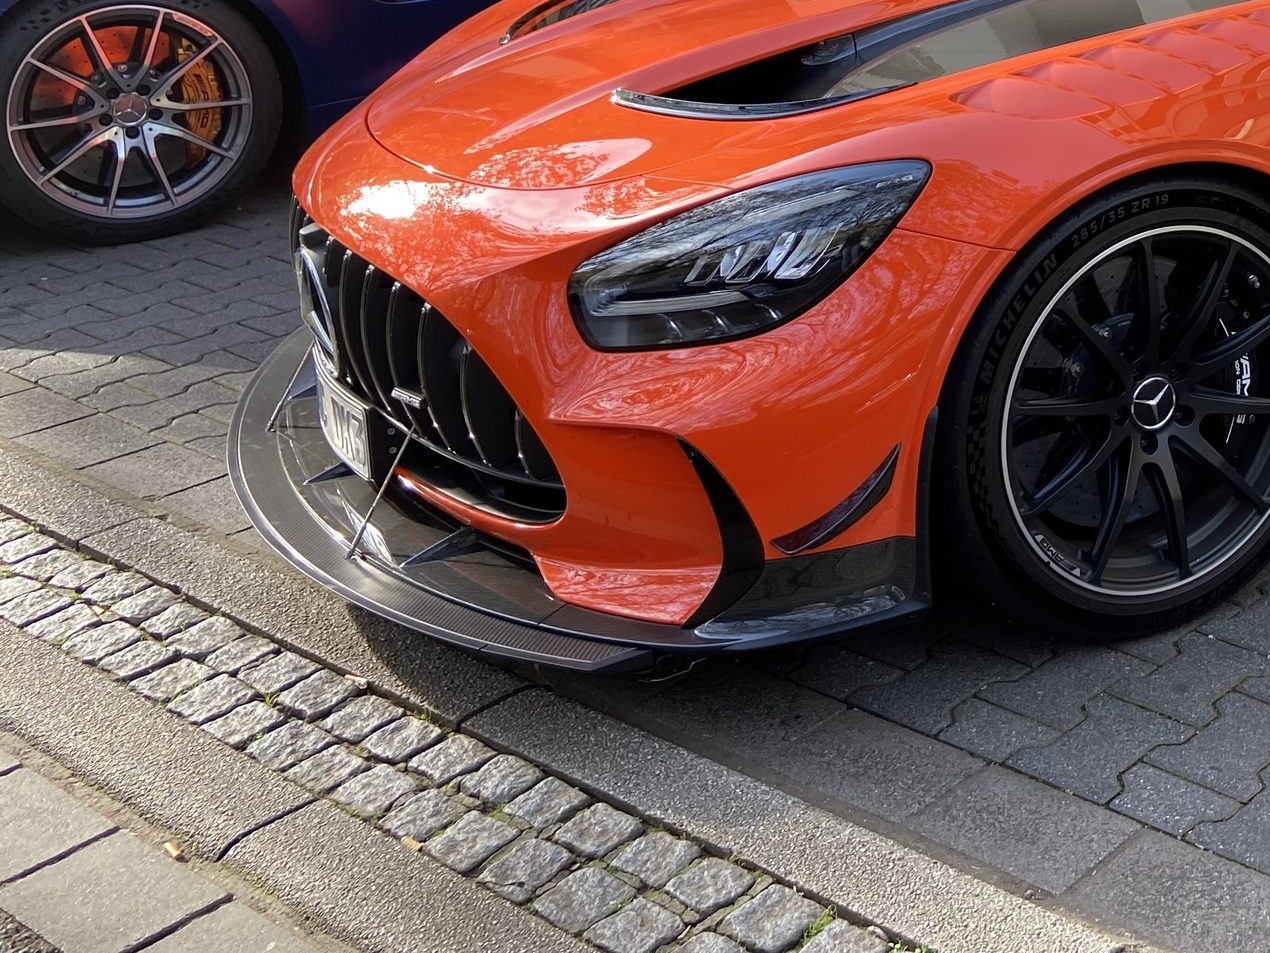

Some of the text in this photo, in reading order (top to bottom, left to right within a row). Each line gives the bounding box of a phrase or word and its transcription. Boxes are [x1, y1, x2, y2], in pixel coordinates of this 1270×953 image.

[980, 194, 1169, 385] MICHELIN 285/35 ZR 19
